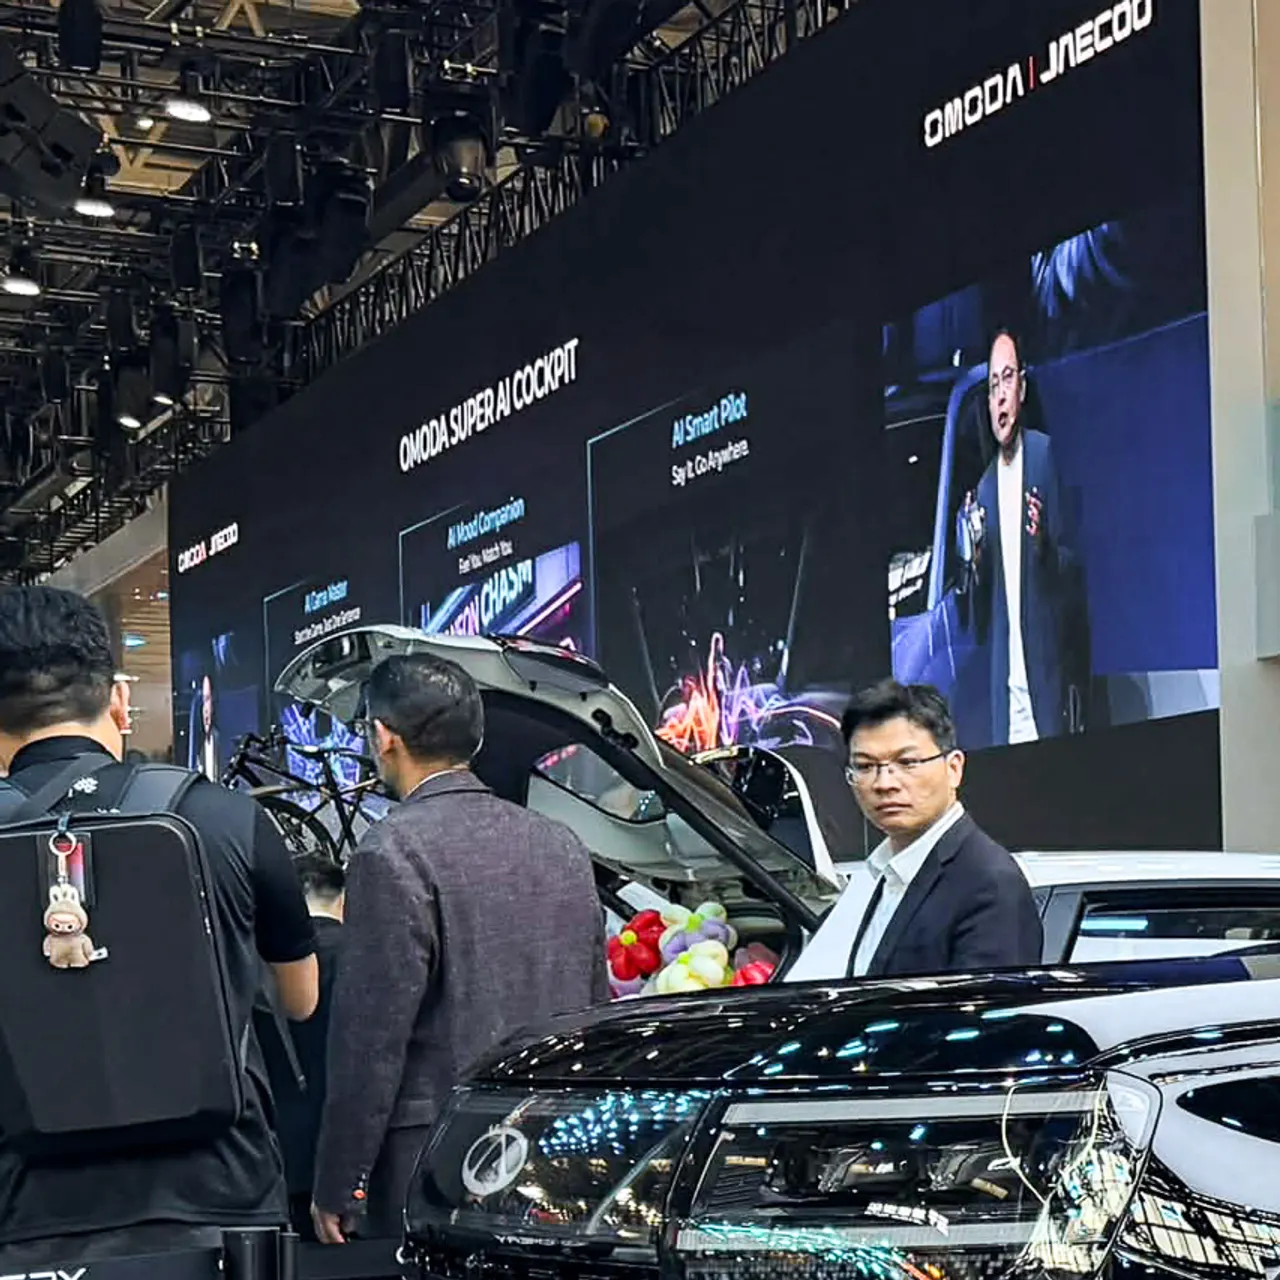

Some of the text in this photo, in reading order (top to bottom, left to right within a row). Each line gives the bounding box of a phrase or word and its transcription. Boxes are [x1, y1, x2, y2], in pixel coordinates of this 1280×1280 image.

[924, 0, 1154, 148] OMODA JAECOO
[399, 336, 580, 473] OMODA SUPER AI COCKPIT
[672, 391, 748, 450] AI Smart Pilot
[480, 558, 533, 628] CHASM
